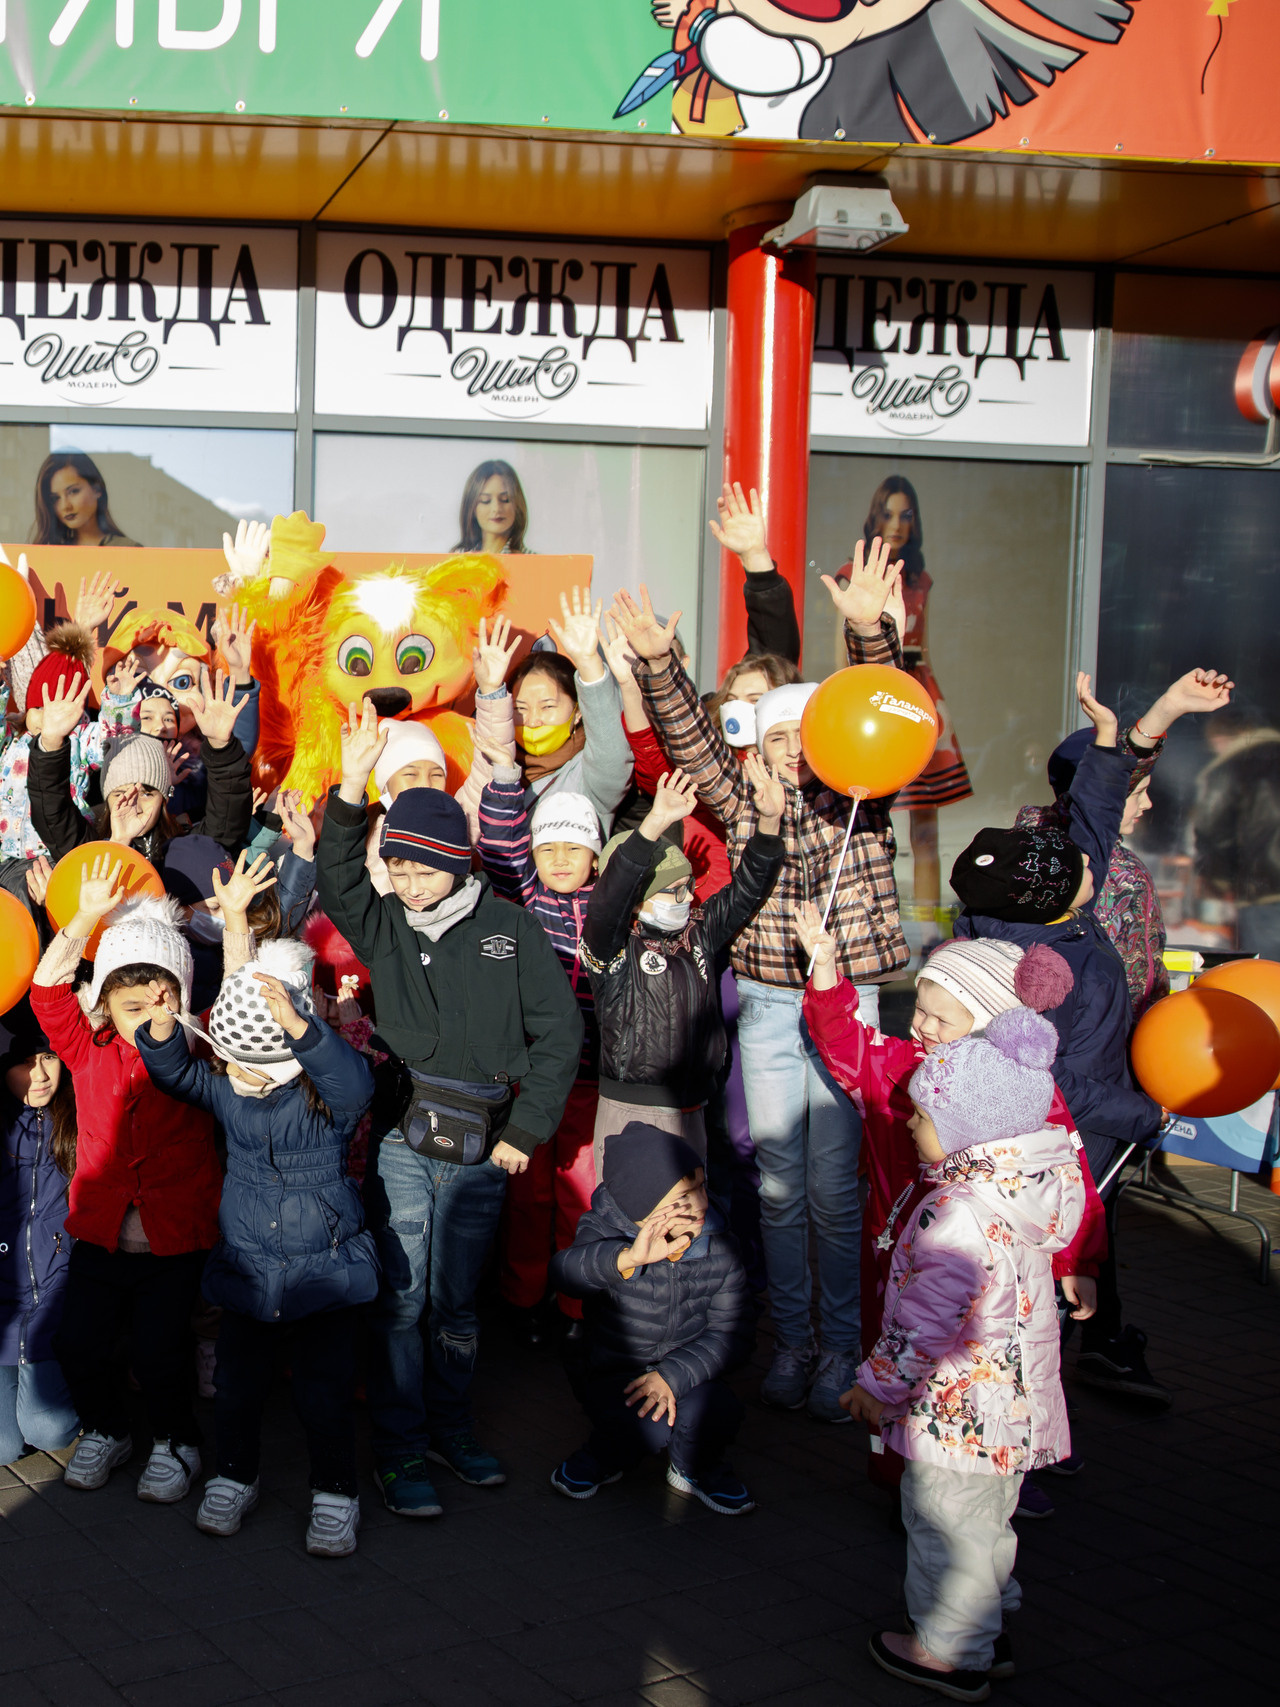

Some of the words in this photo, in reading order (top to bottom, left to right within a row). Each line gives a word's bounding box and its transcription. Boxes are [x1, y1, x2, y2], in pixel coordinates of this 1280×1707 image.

[344, 248, 684, 362] ОДЕЖДА
[814, 273, 1070, 380] ДЕЖДА
[67, 380, 118, 390] МОДЕРН
[491, 393, 540, 403] МОДЕРН
[882, 694, 936, 727] Галамарт
